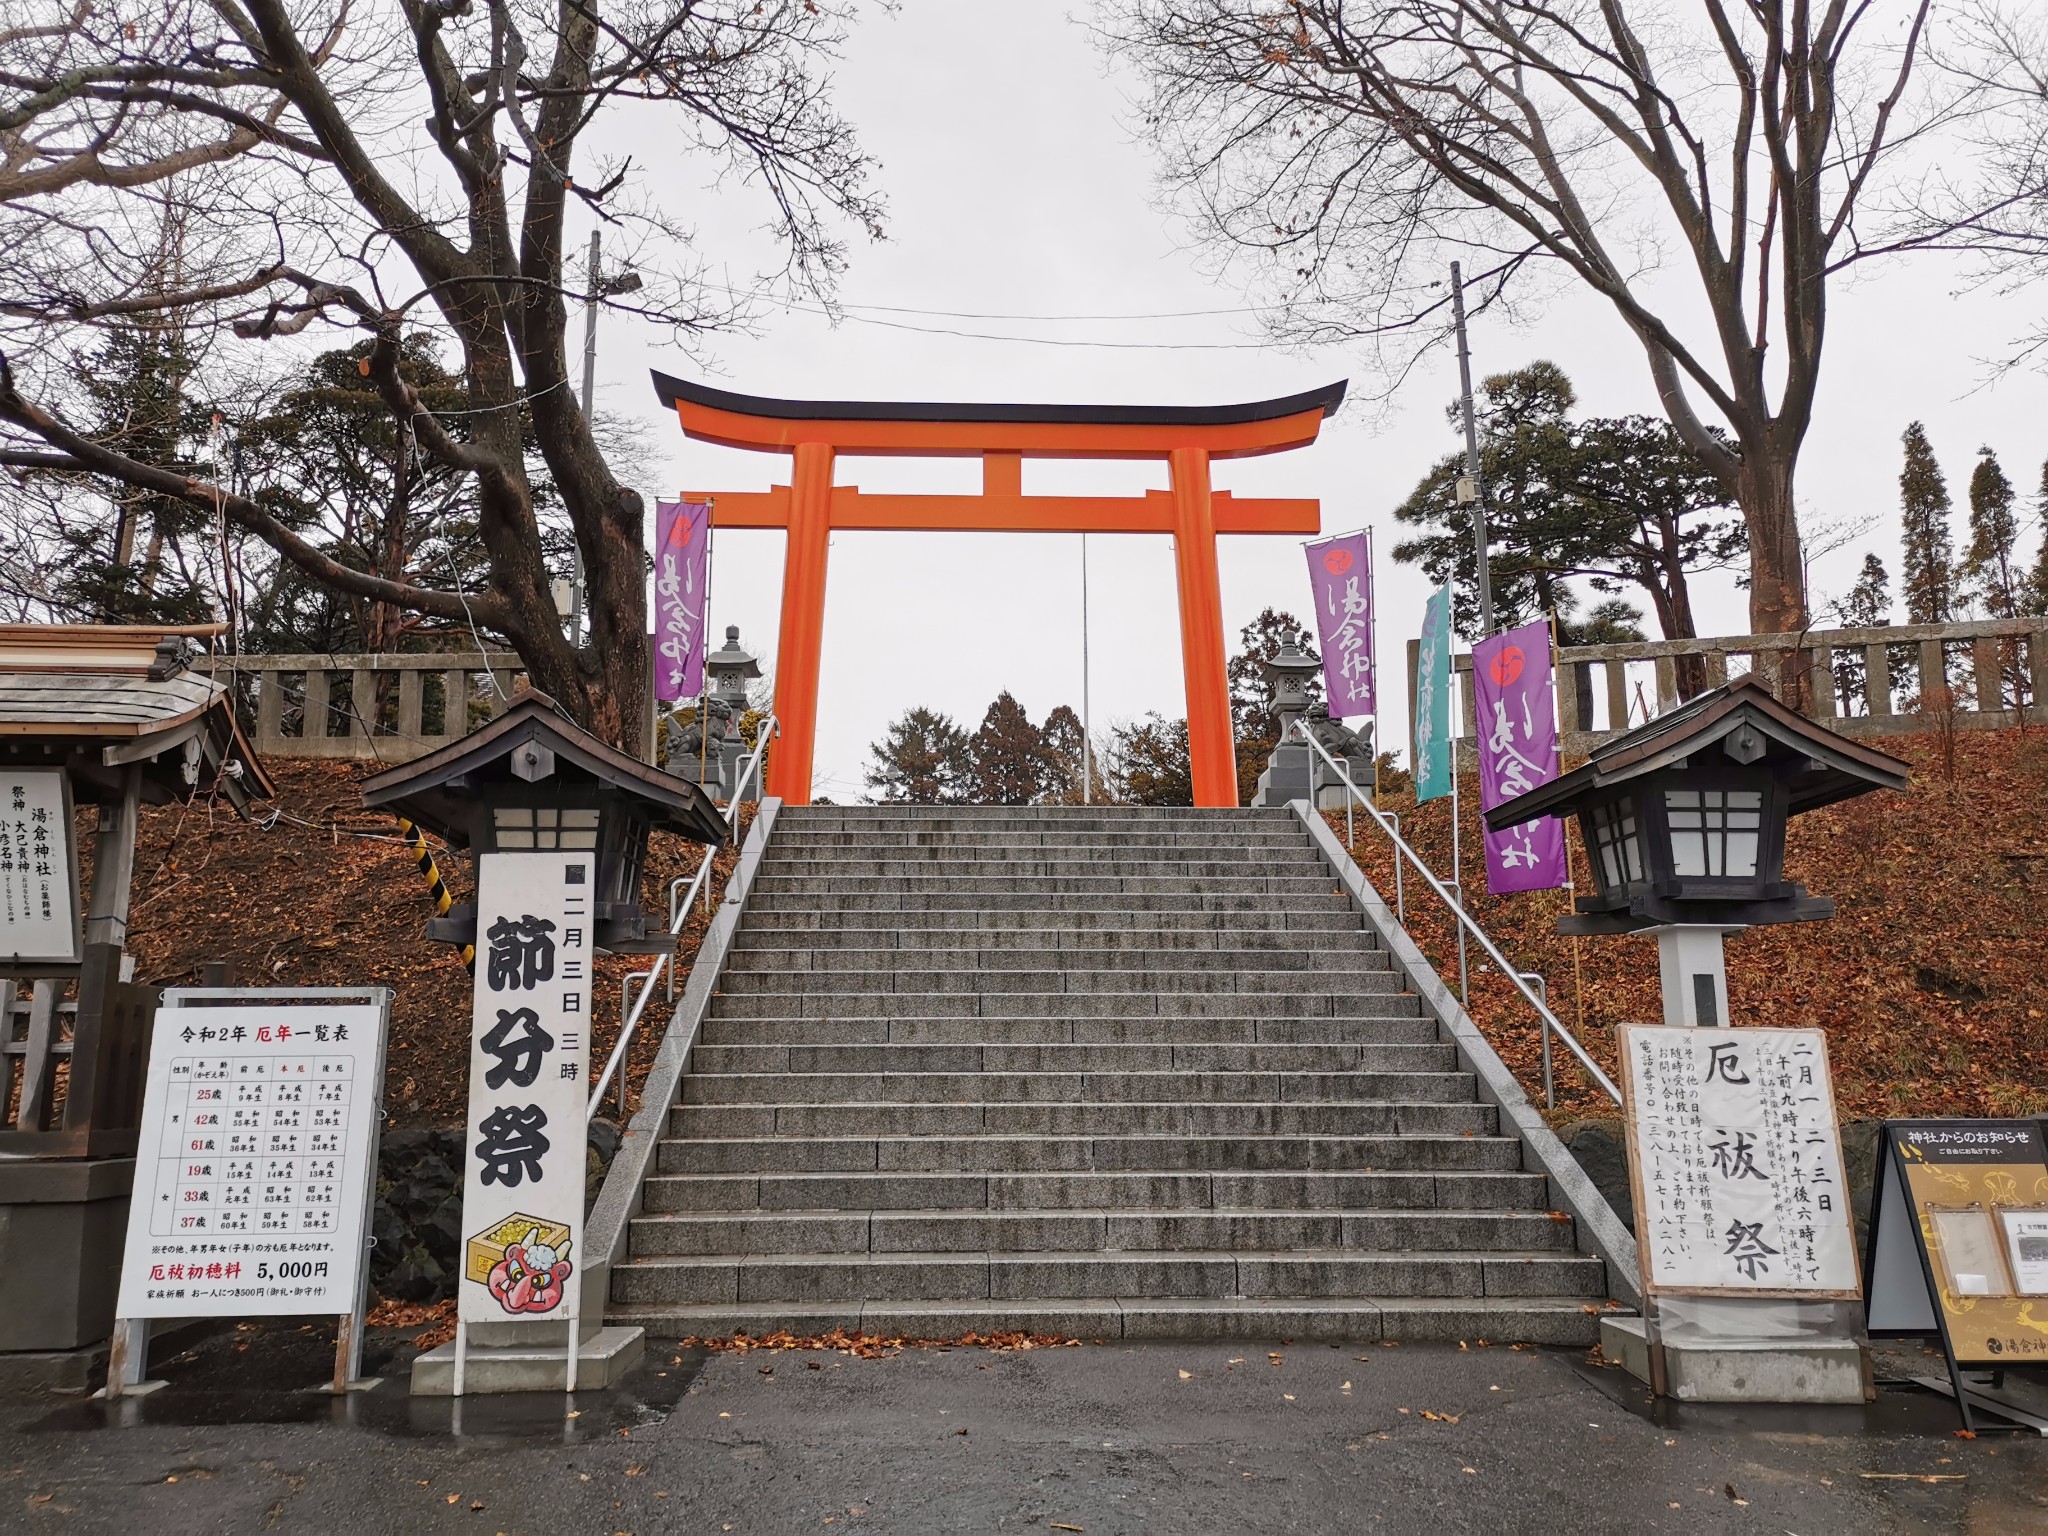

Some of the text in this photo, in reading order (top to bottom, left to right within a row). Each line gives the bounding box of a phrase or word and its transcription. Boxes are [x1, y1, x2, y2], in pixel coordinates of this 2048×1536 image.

[12, 786, 25, 812] 祭神
[179, 1024, 349, 1044] 令和2年 厄年一覧表
[475, 914, 556, 1188] 節分祭
[173, 1066, 190, 1074] 性別
[197, 1089, 222, 1101] 25歳
[238, 1094, 262, 1102] 9年生
[319, 1093, 341, 1101] 7年生
[171, 1115, 179, 1124] 男
[194, 1114, 219, 1125] 42歳
[233, 1119, 259, 1127] 55年生
[273, 1119, 299, 1127] 54年生
[314, 1118, 340, 1126] 53年生
[1908, 1132, 2029, 1144] 神社からのお知らせ
[191, 1140, 215, 1151] 61歳
[270, 1144, 296, 1152] 35年生
[1705, 1042, 1781, 1281] 厄祓祭
[188, 1165, 212, 1176] 19歳
[226, 1171, 252, 1179] 15年生
[267, 1171, 293, 1179] 14年生
[309, 1170, 334, 1178] 13年生
[184, 1191, 209, 1202] 33歳
[264, 1195, 291, 1203] 63年生
[181, 1216, 206, 1228] 37歳
[220, 1221, 247, 1229] 60年生
[261, 1221, 287, 1229] 59年生
[303, 1220, 329, 1228] 58年生
[148, 1261, 328, 1281] 厄祓初穂料 5,000円
[147, 1289, 185, 1299] 家族祈願
[2004, 1338, 2048, 1354] 湯倉神
